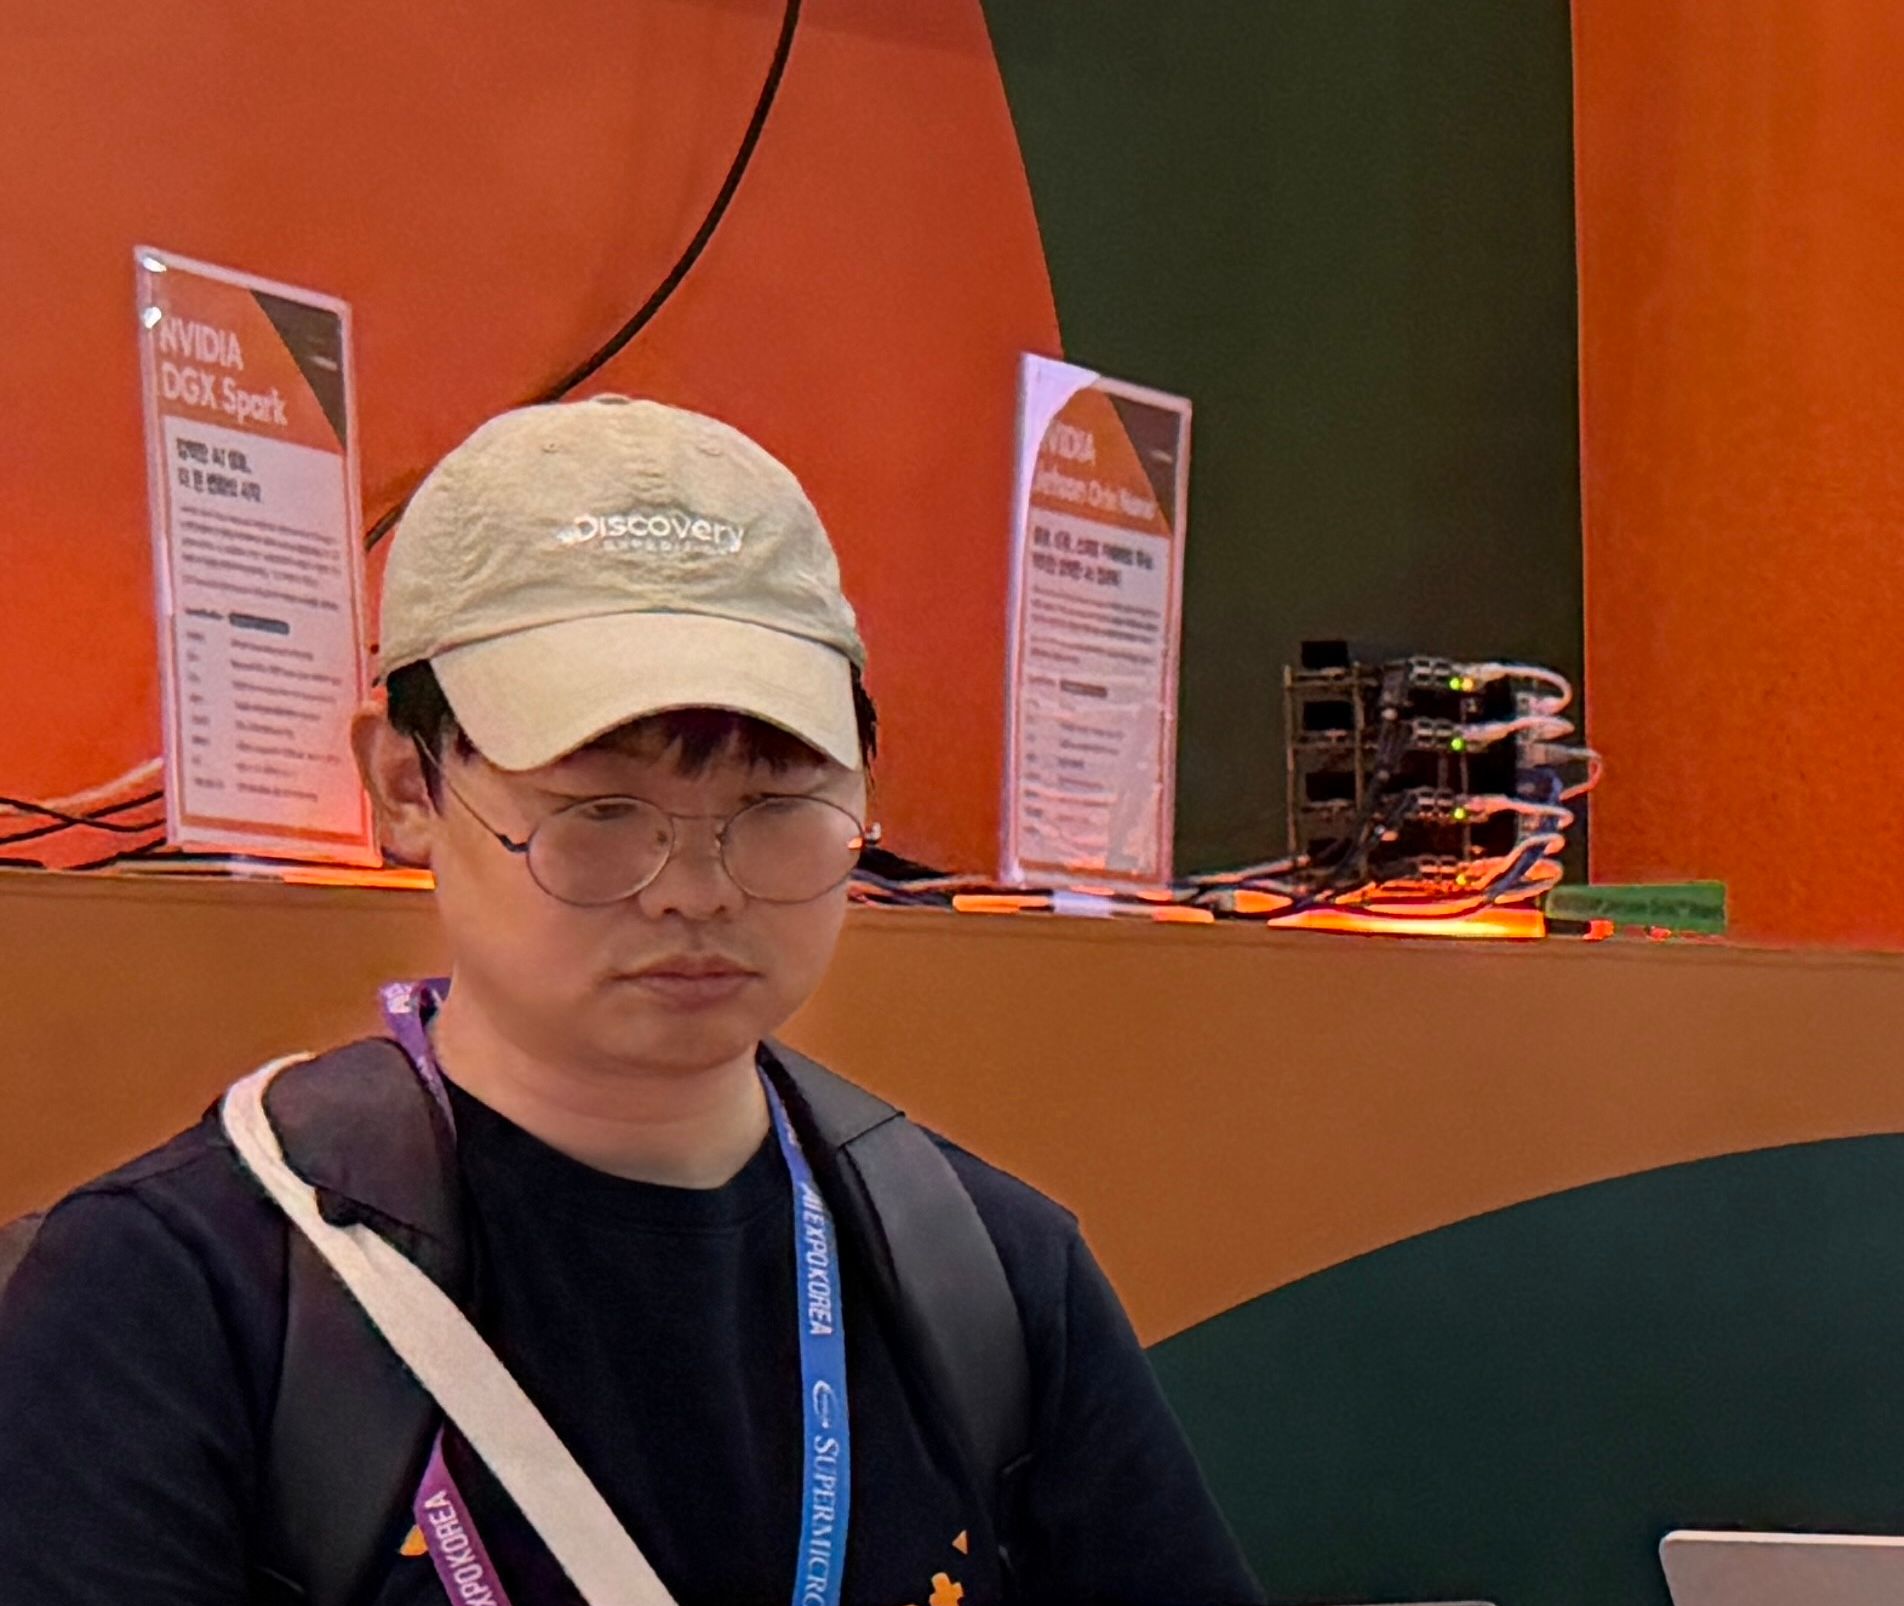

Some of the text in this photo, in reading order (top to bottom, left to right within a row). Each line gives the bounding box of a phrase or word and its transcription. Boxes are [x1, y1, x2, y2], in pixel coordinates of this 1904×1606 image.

[160, 317, 244, 371] NVIDIA
[161, 361, 288, 425] DGX Spark
[572, 511, 745, 553] Discovery
